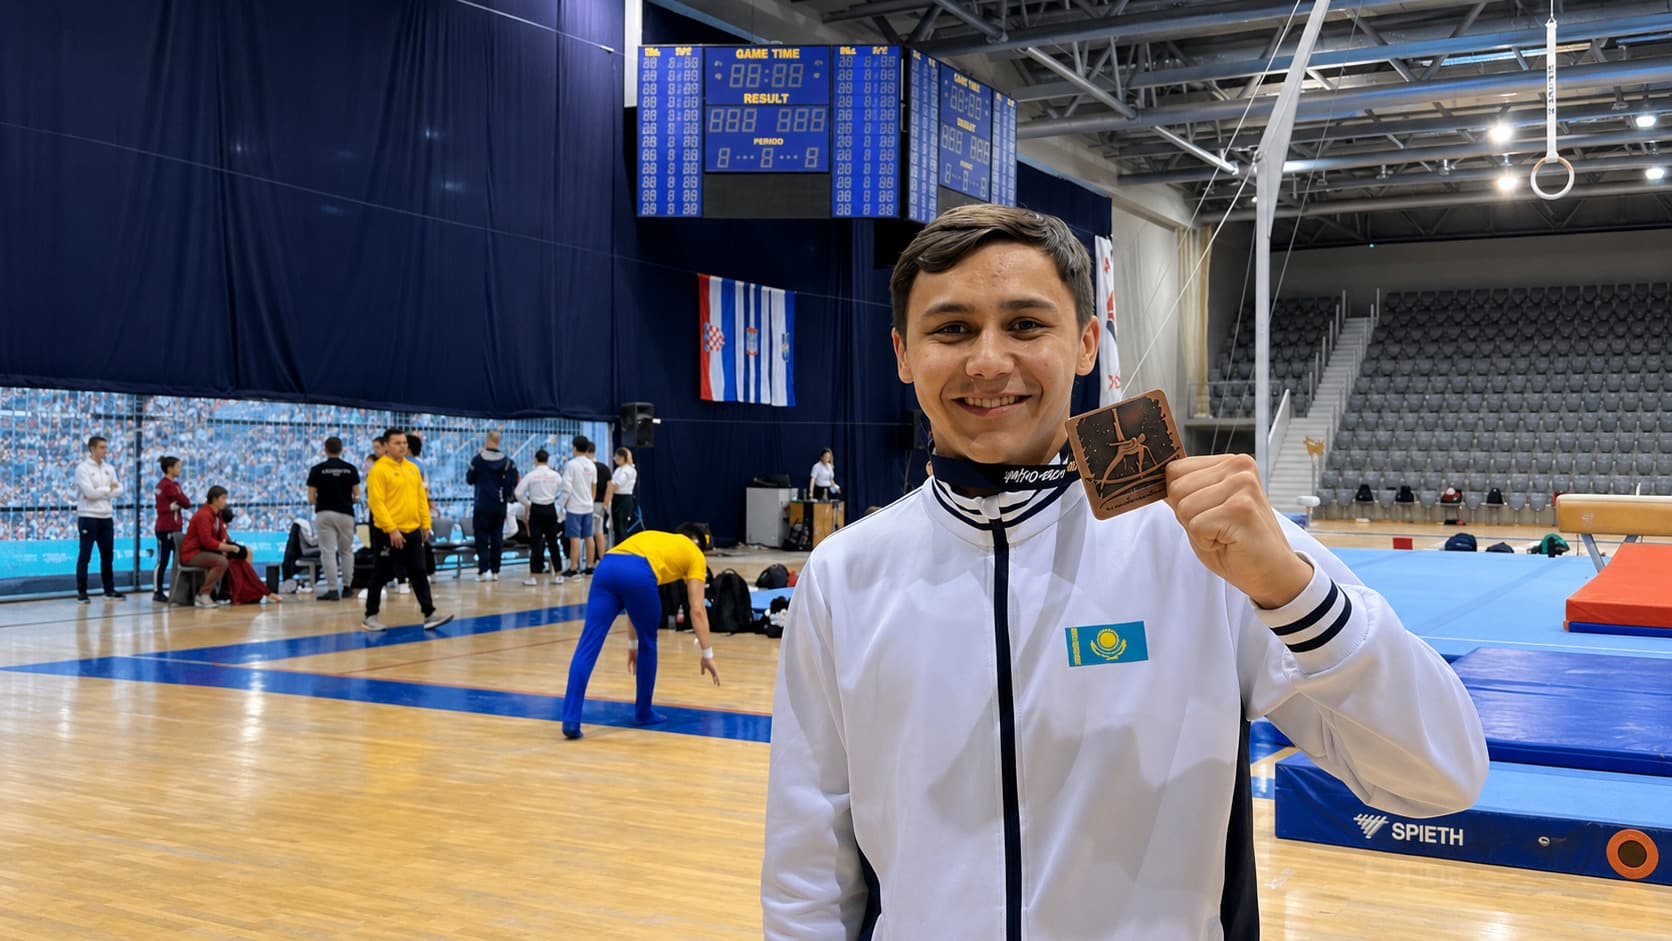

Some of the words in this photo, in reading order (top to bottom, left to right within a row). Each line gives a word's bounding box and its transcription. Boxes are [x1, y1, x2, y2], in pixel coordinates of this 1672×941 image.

[736, 48, 768, 59] GAME
[771, 48, 800, 59] TIME
[743, 93, 789, 104] RESULT
[1391, 822, 1464, 846] SPIETH
